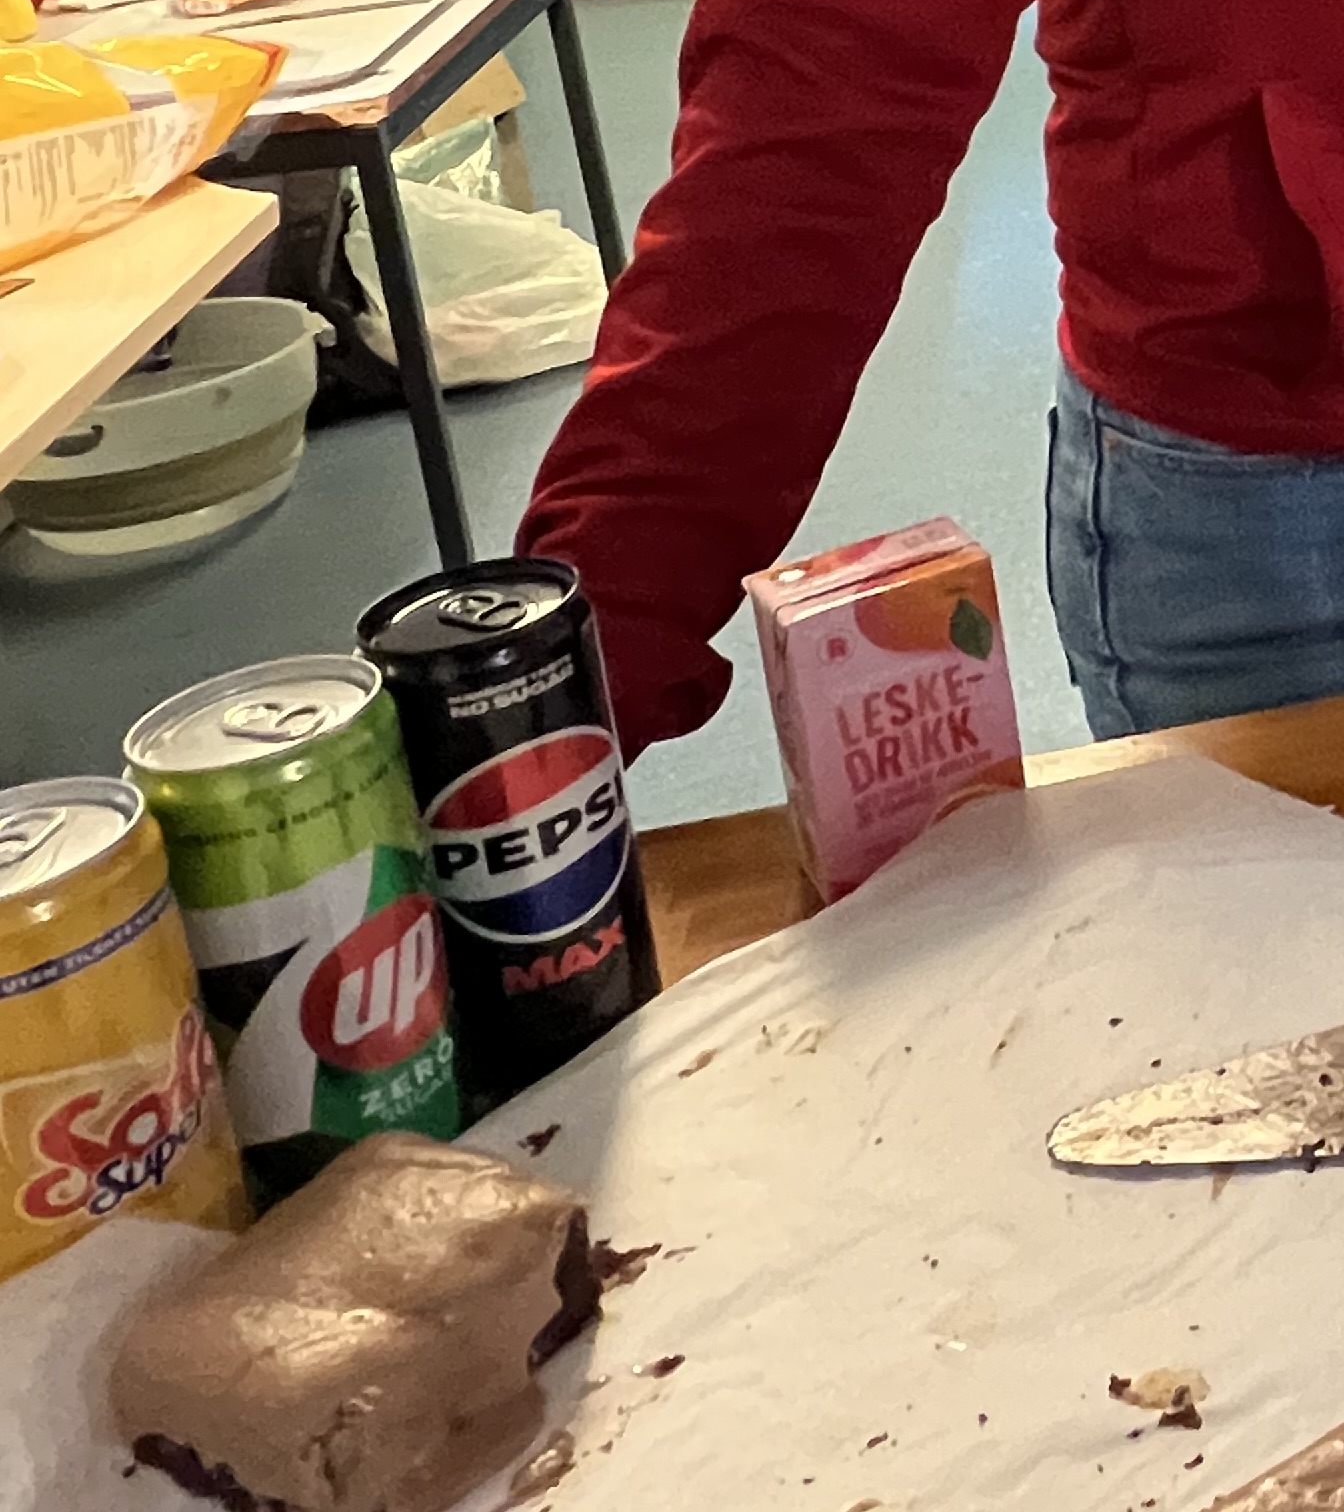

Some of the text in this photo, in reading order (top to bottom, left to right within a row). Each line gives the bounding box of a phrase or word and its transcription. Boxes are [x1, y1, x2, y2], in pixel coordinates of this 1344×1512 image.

[449, 699, 490, 719] NO
[836, 662, 985, 748] LESKE-
[843, 706, 981, 795] DRIKK
[502, 913, 626, 994] MAX
[359, 1036, 454, 1119] ZERO
